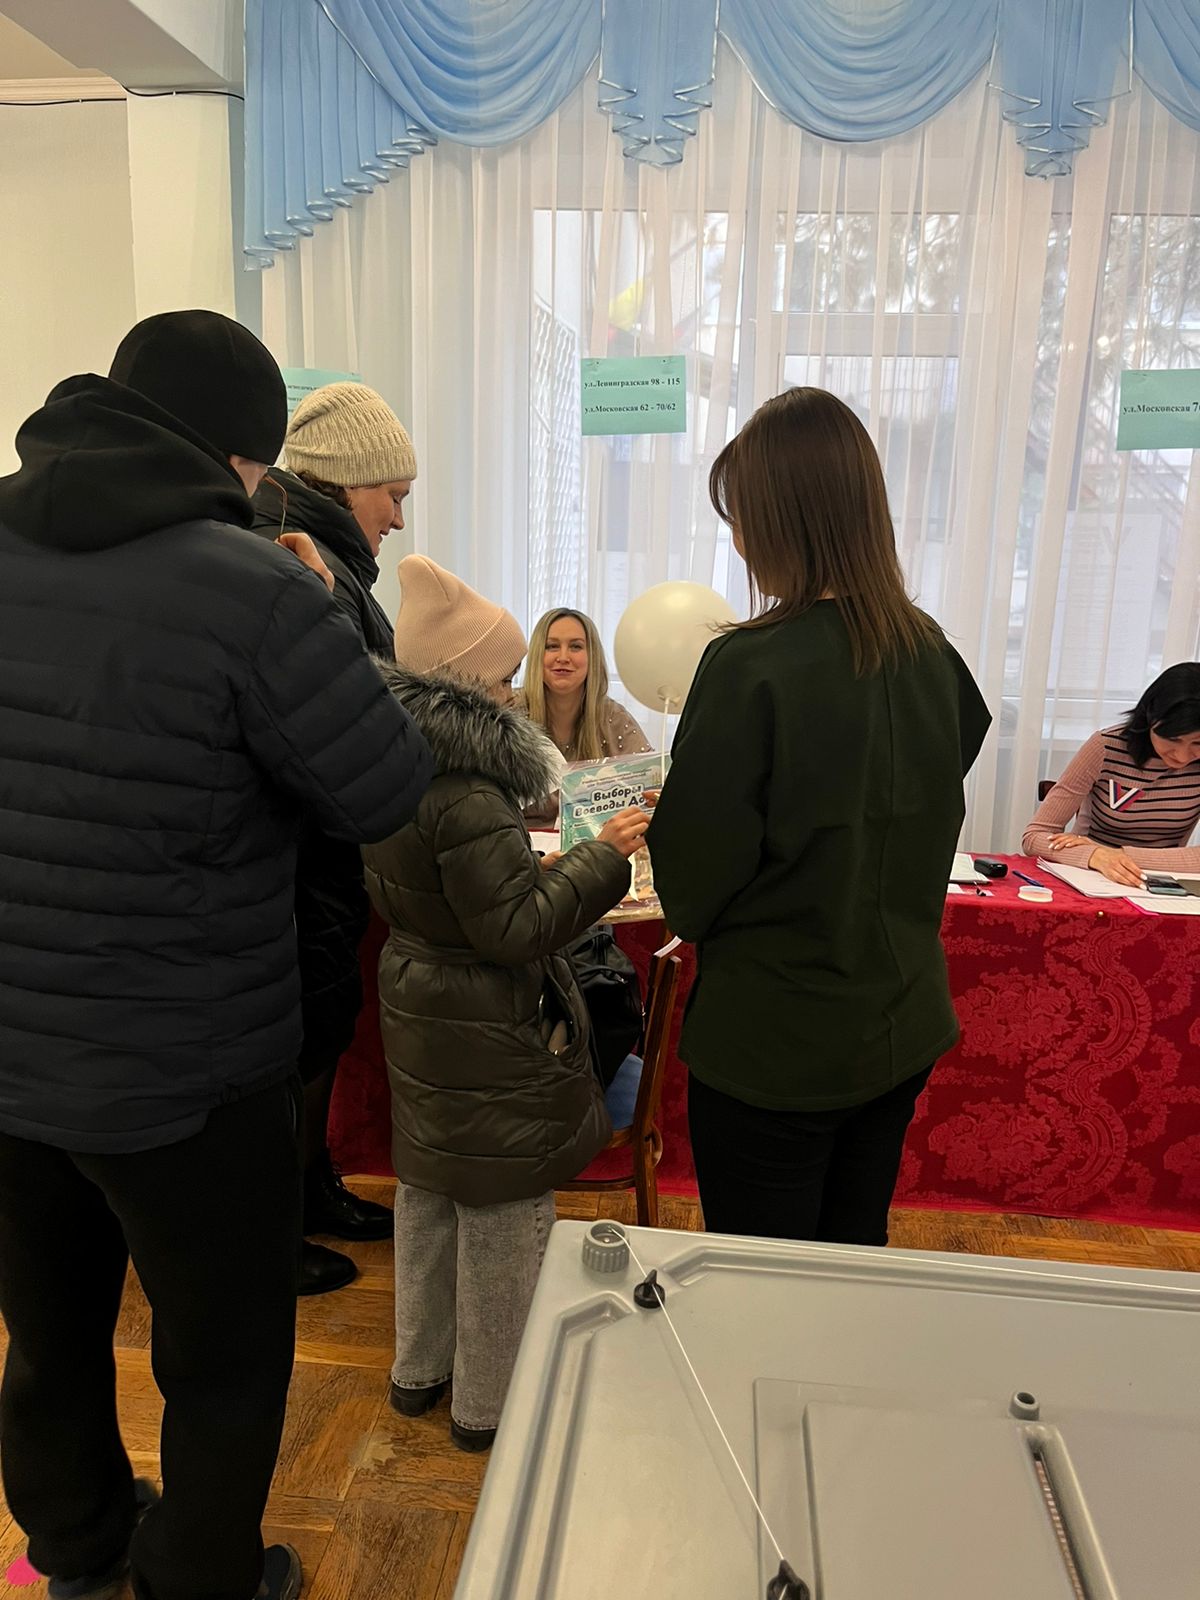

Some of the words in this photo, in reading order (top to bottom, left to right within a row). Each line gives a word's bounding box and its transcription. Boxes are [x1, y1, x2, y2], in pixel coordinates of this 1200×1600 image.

[584, 380, 649, 390] ул.Ленинградская
[650, 378, 660, 386] 98
[584, 405, 639, 415] ул.Московская
[656, 403, 676, 411] 70/62
[1123, 404, 1191, 415] ул.Московская
[1192, 402, 1200, 412] 7
[593, 785, 641, 801] Выборы
[575, 800, 625, 817] Воеводы
